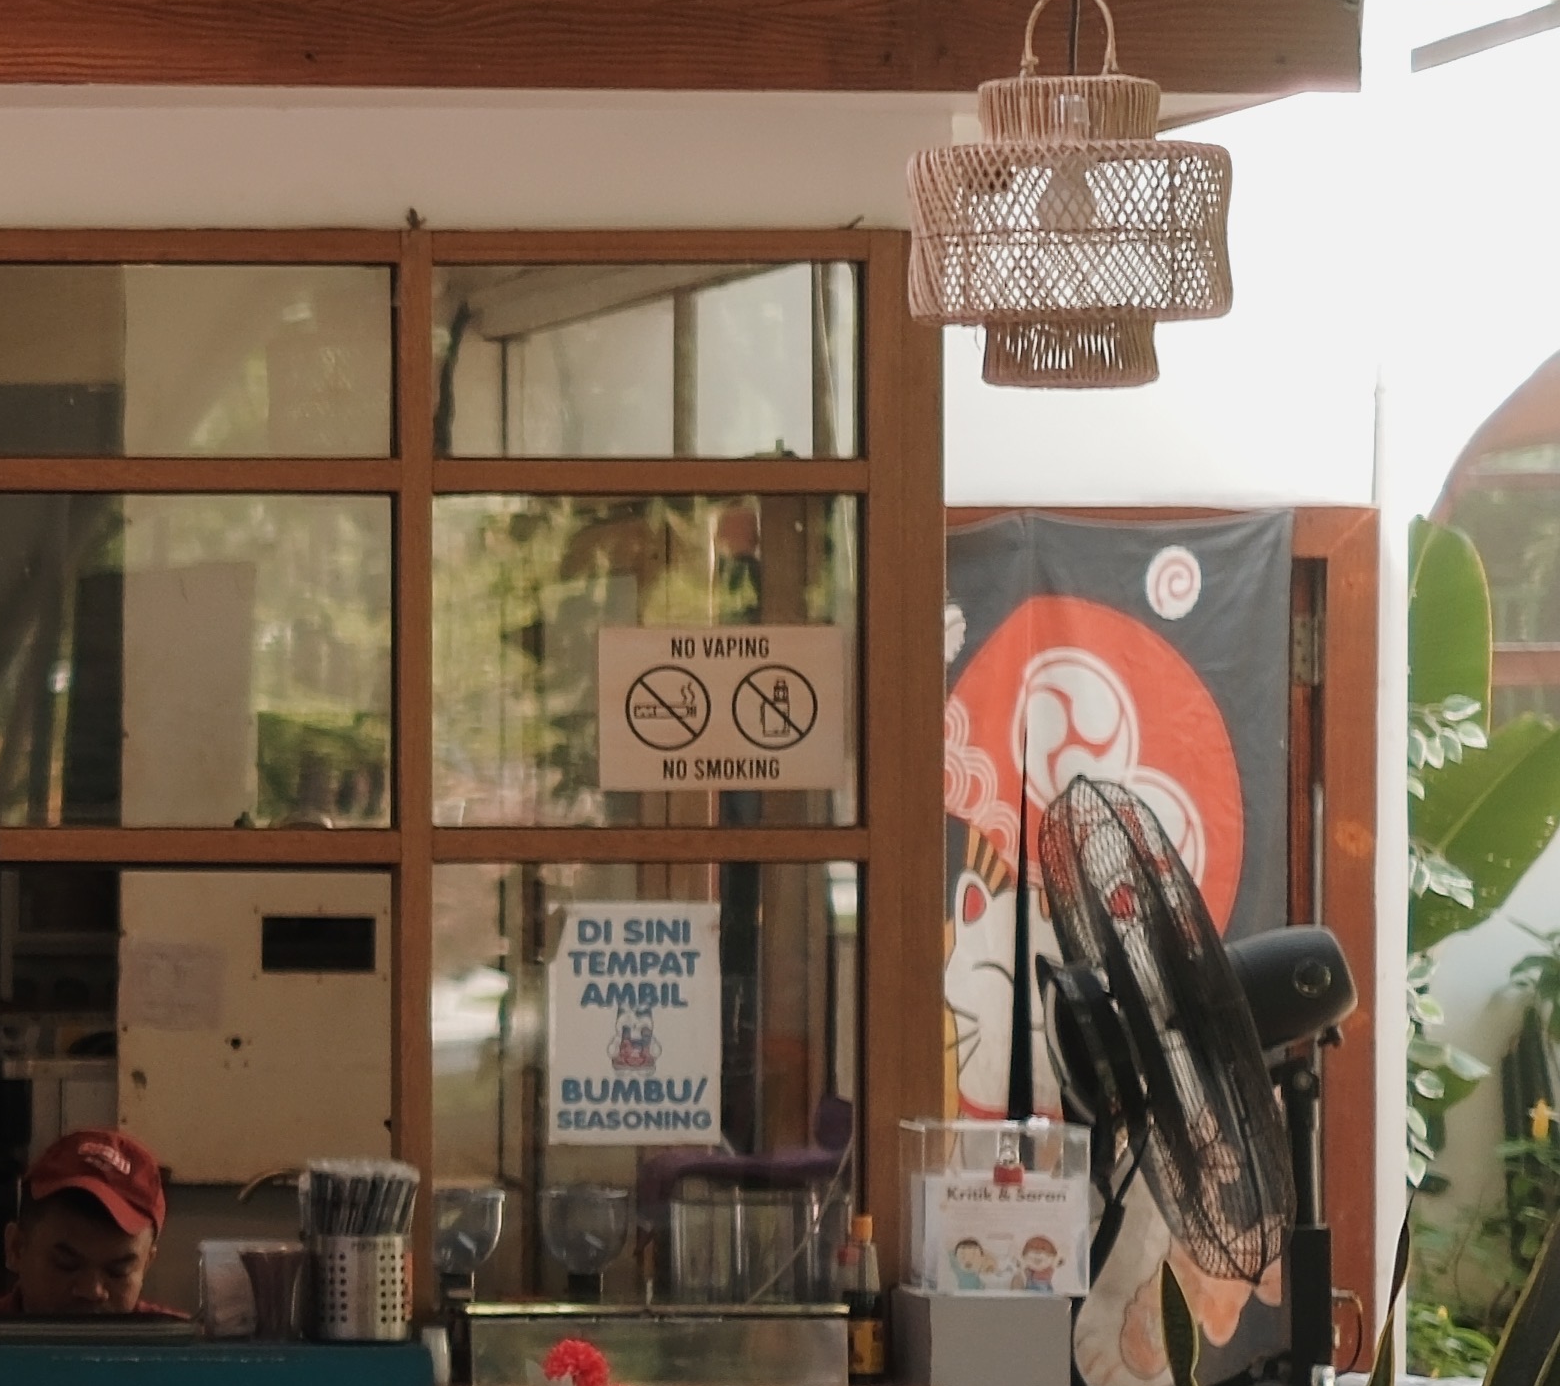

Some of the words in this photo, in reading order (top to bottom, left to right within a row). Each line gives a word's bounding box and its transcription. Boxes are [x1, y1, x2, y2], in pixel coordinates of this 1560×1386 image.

[671, 637, 696, 658] NO
[702, 637, 770, 659] VAPING
[662, 759, 688, 780] NO
[694, 758, 781, 781] SMOKING
[577, 919, 612, 945] DI
[623, 919, 691, 945] SINI
[567, 950, 701, 978] TEMPAT
[580, 981, 689, 1009] AMBIL
[560, 1076, 709, 1106] BUMBU/
[556, 1109, 713, 1131] SEASONING
[947, 1187, 992, 1203] Kritik
[998, 1188, 1011, 1202] &
[1015, 1188, 1067, 1203] Saran
